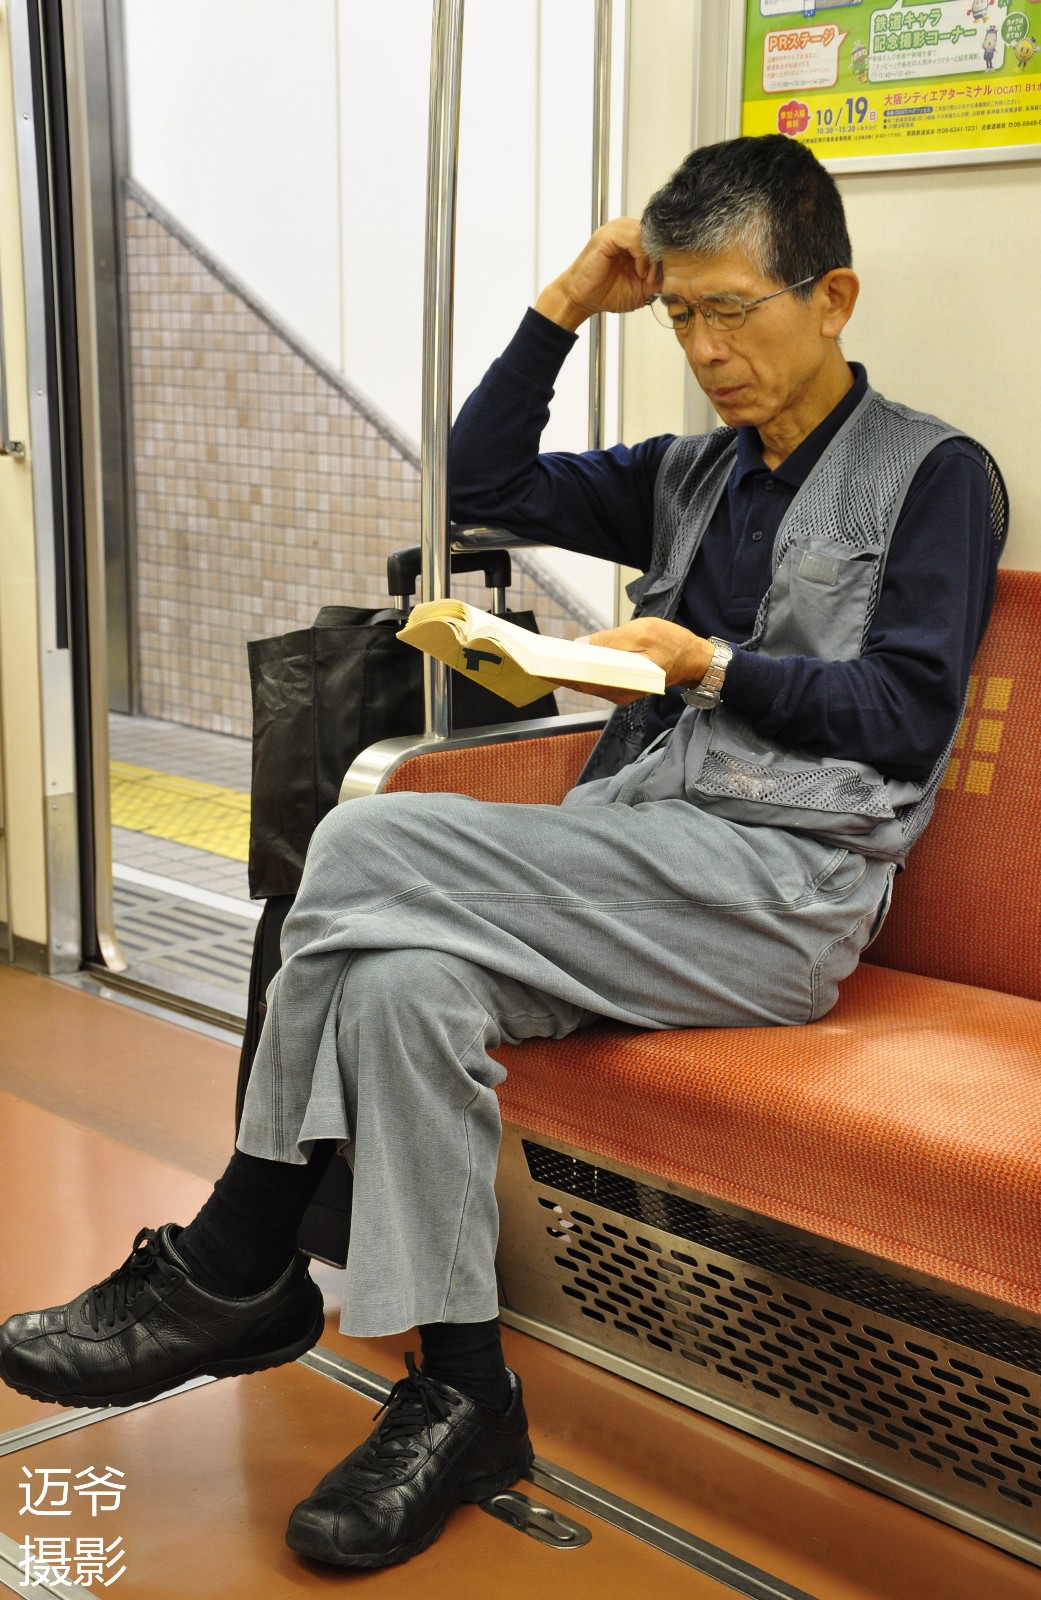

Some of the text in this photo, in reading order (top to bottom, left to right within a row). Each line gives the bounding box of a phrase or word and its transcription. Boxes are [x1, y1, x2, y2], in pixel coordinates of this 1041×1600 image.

[874, 8, 942, 33] 鉄道キャラ
[768, 28, 835, 52] PRステージ
[873, 25, 977, 53] 記念撮影コーナー
